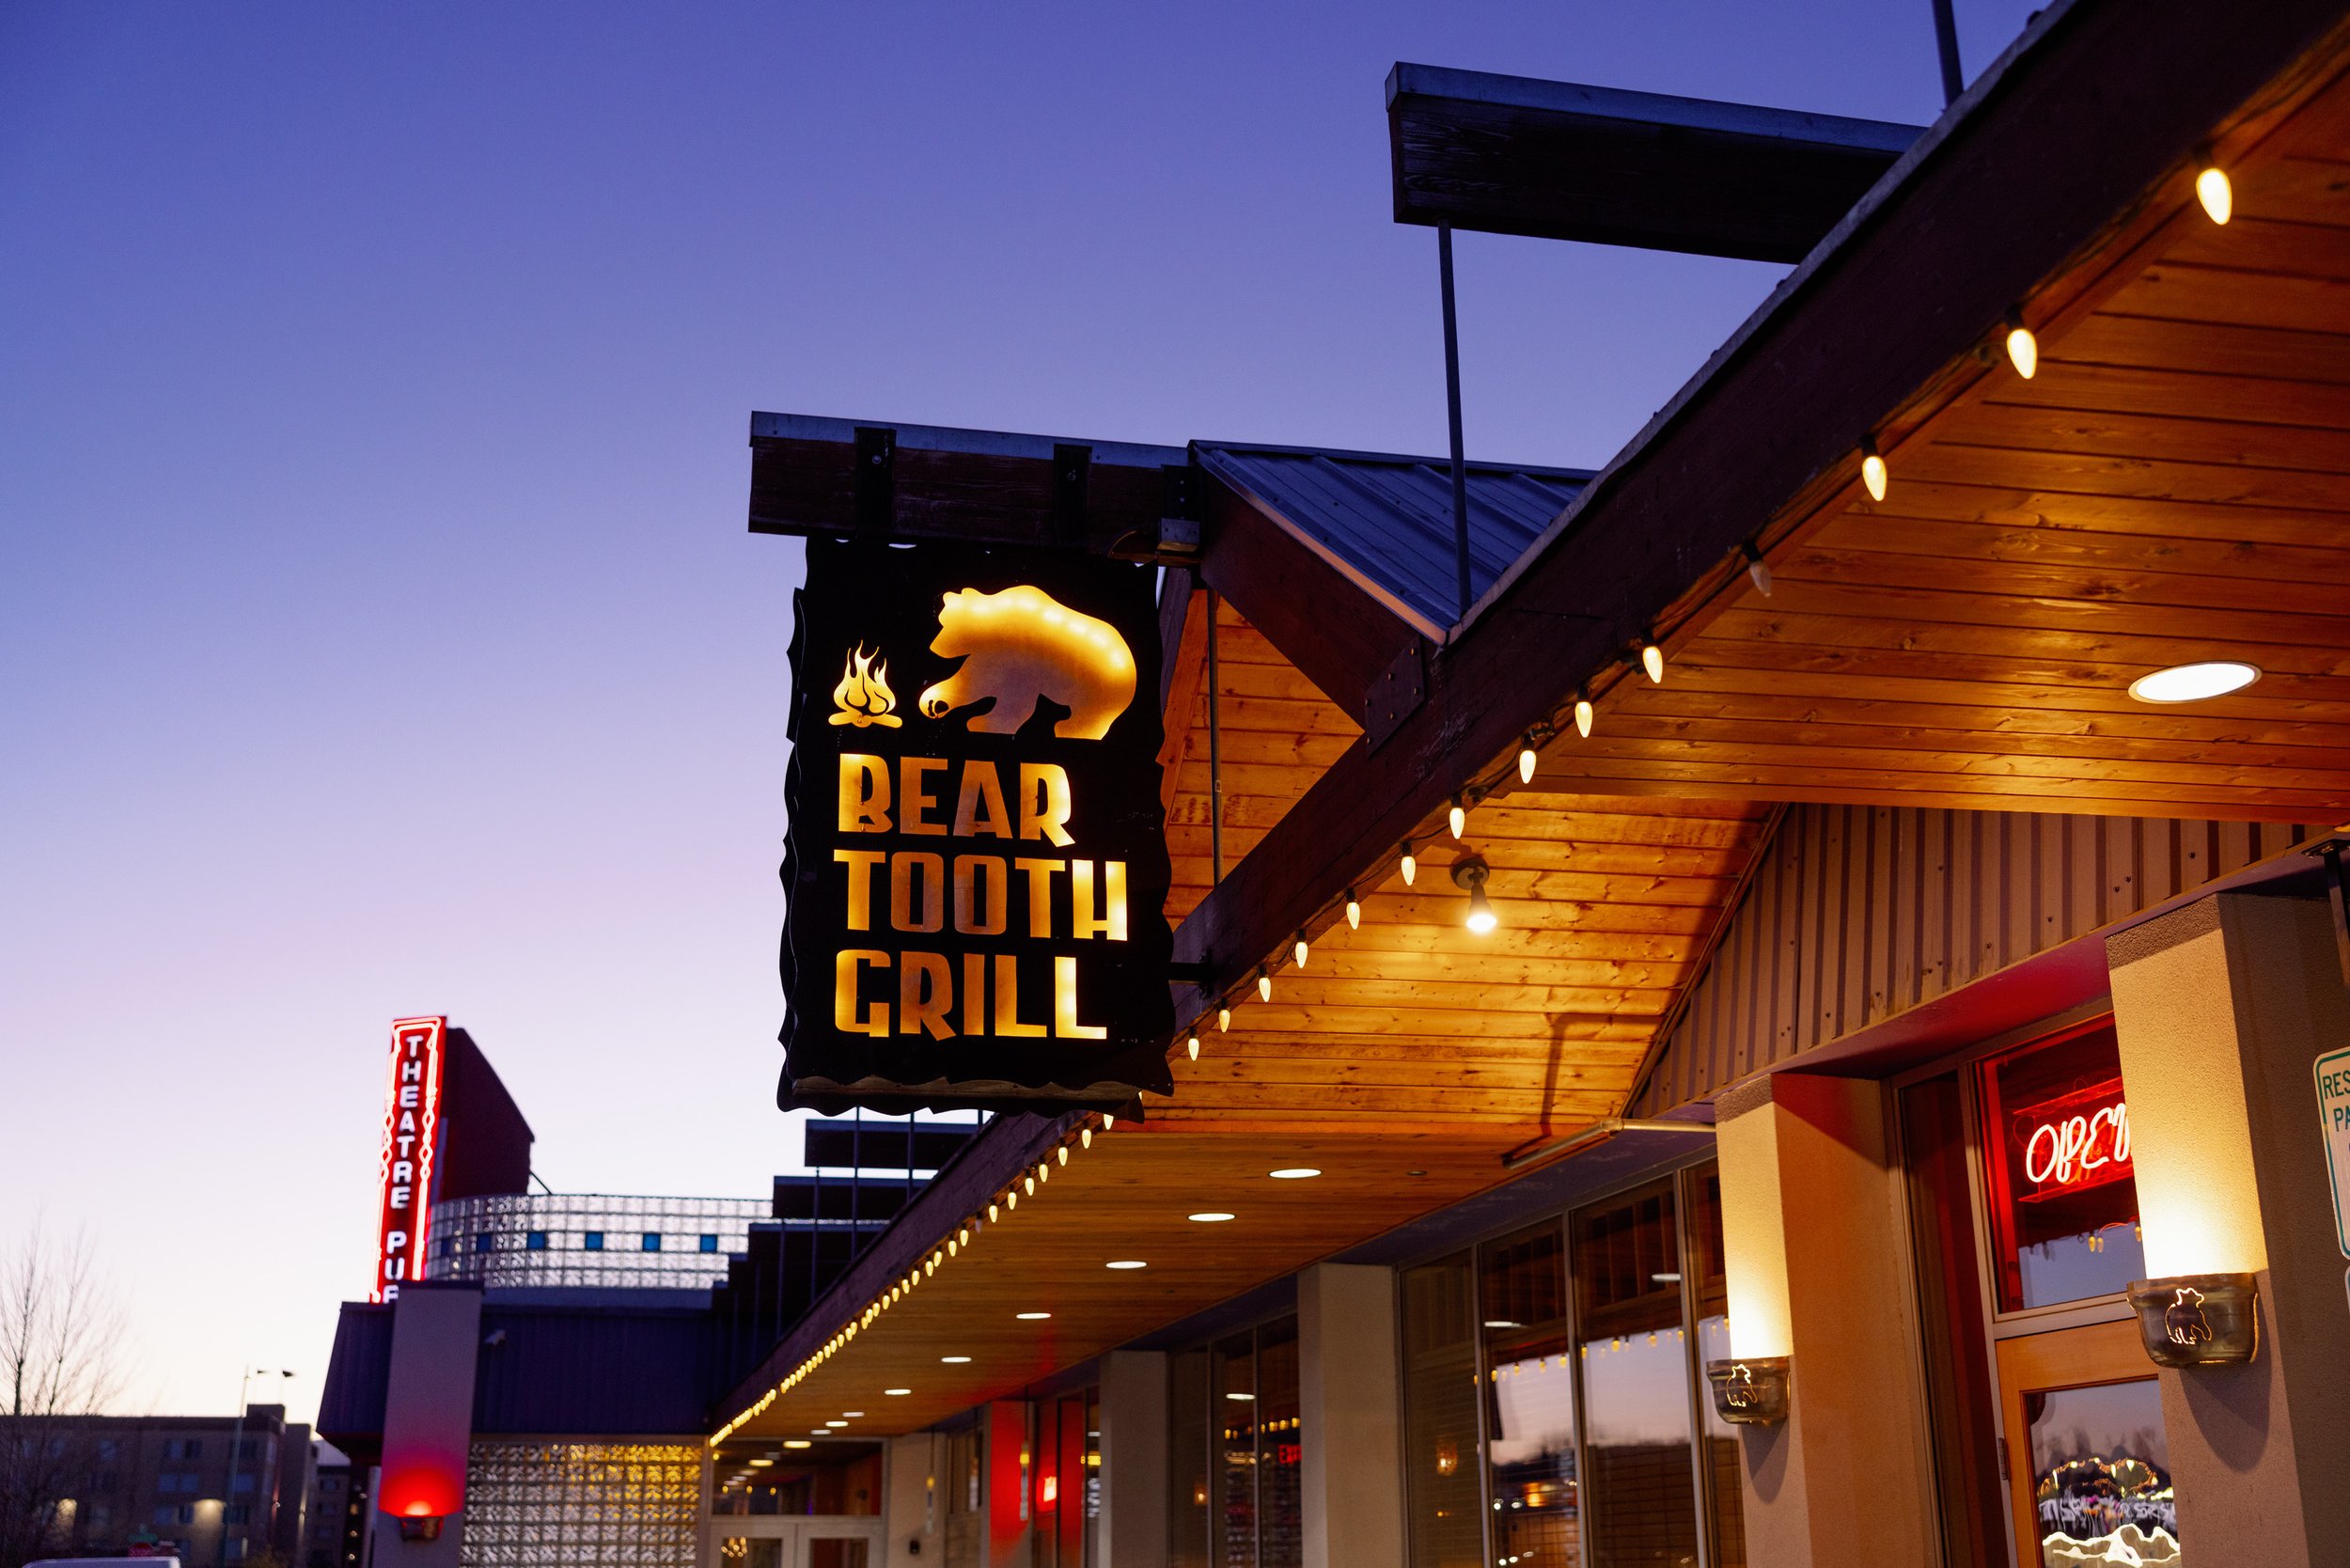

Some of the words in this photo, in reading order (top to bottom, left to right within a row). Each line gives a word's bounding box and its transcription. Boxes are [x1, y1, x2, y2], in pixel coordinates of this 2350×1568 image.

[838, 753, 1075, 847] BEAR
[834, 849, 1127, 941] TOOTH
[835, 949, 1107, 1041] GRILL
[390, 1035, 424, 1209] THEATRE
